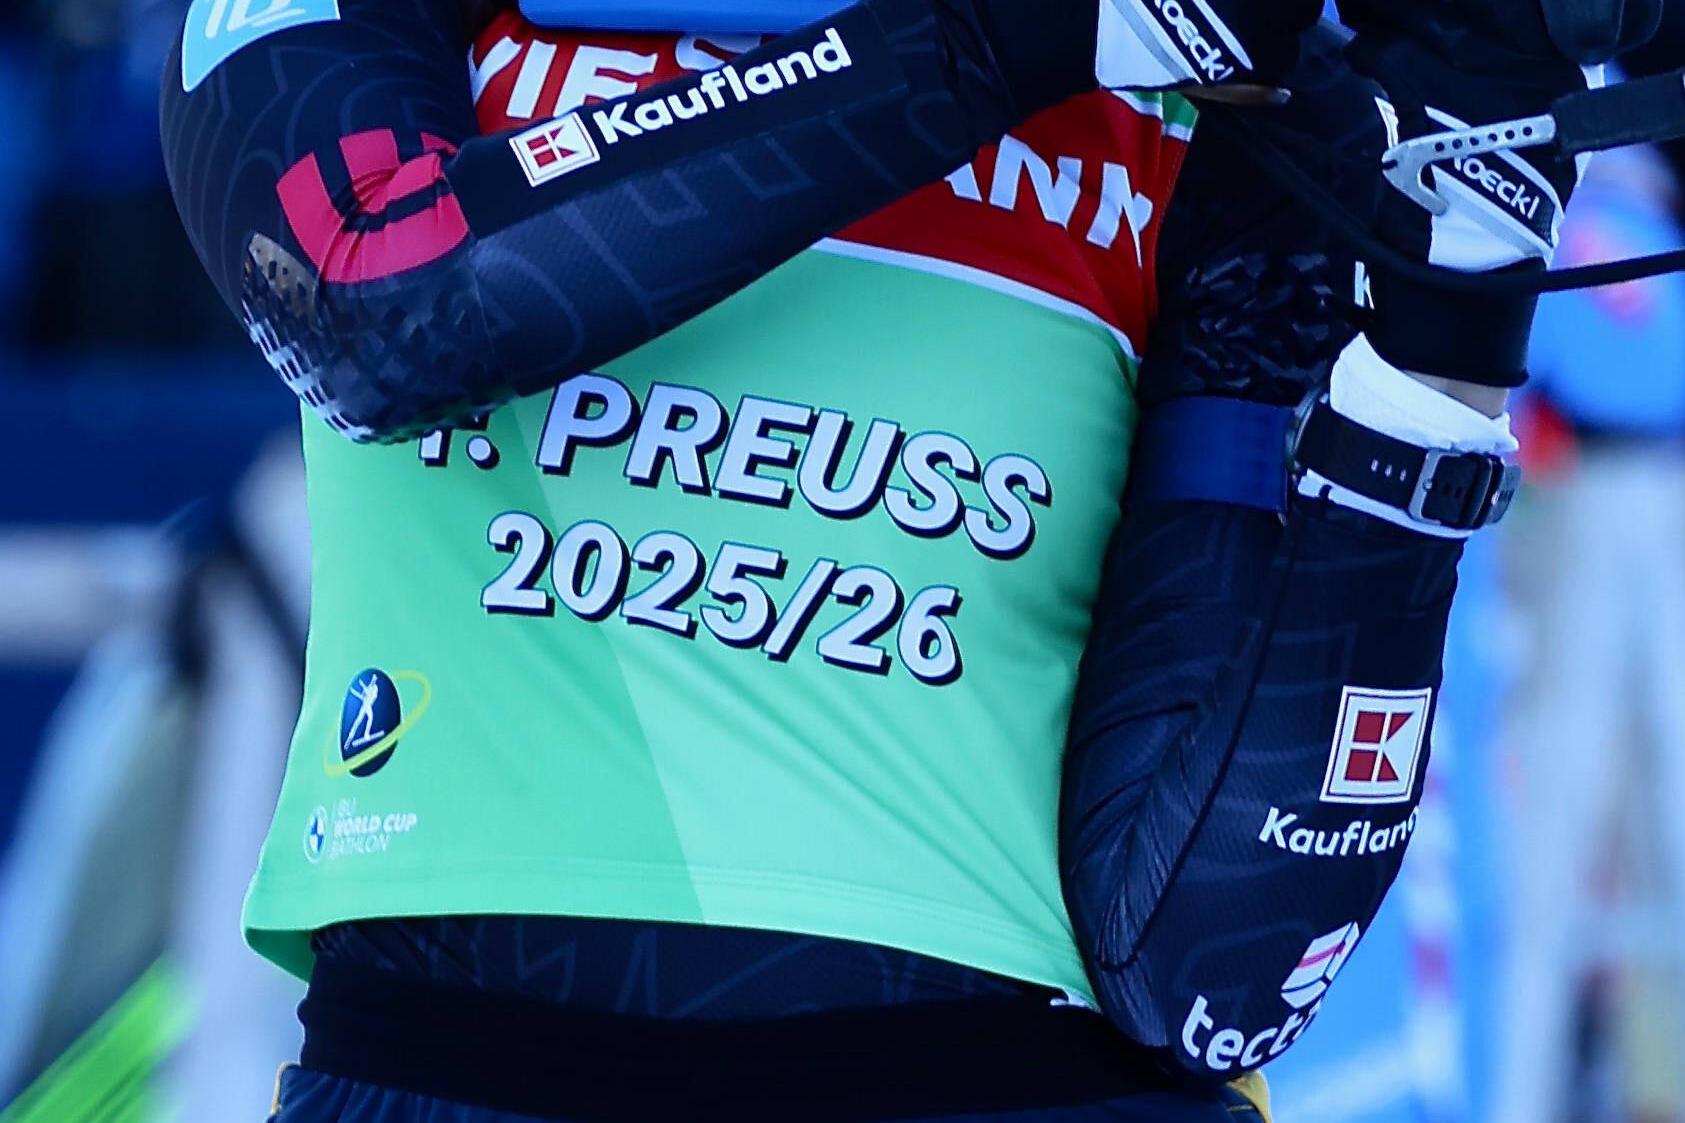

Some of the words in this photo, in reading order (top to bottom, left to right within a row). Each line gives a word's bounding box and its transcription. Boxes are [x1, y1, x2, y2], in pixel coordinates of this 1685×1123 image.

[594, 28, 853, 145] Kaufland
[535, 370, 1053, 560] PREUSS
[480, 509, 964, 686] 2025/26
[382, 811, 418, 833] CUP
